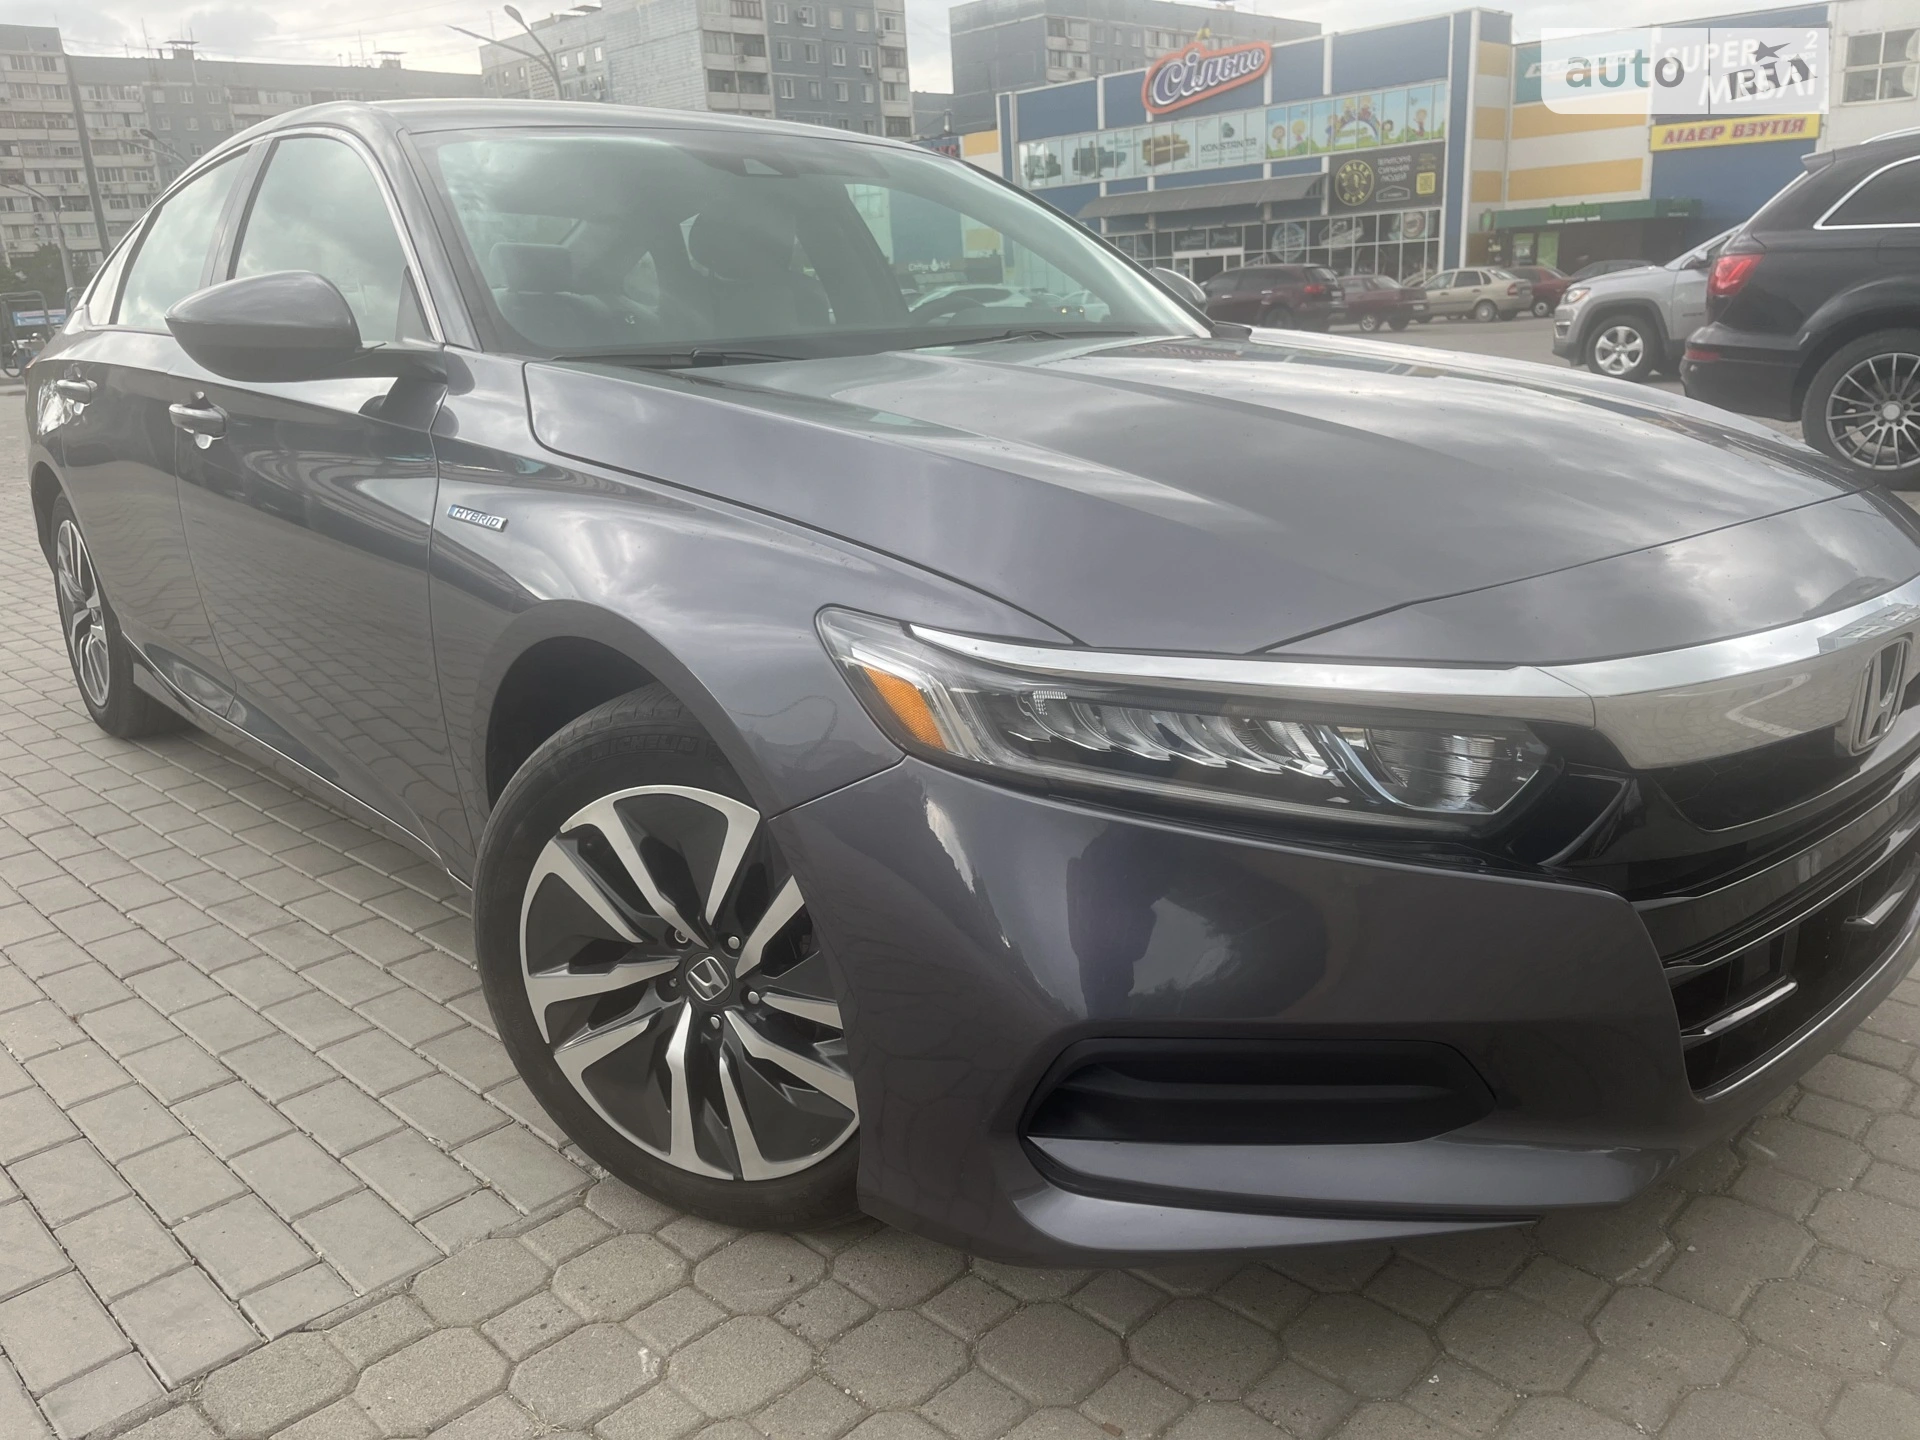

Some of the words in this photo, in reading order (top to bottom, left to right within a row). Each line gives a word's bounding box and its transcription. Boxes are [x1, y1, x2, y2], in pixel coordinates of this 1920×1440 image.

[1663, 125, 1725, 145] ЛІДЕР
[1731, 118, 1806, 139] ВЗУТТЯ
[454, 508, 500, 527] HYBRID
[591, 734, 698, 762] MICHELIN
